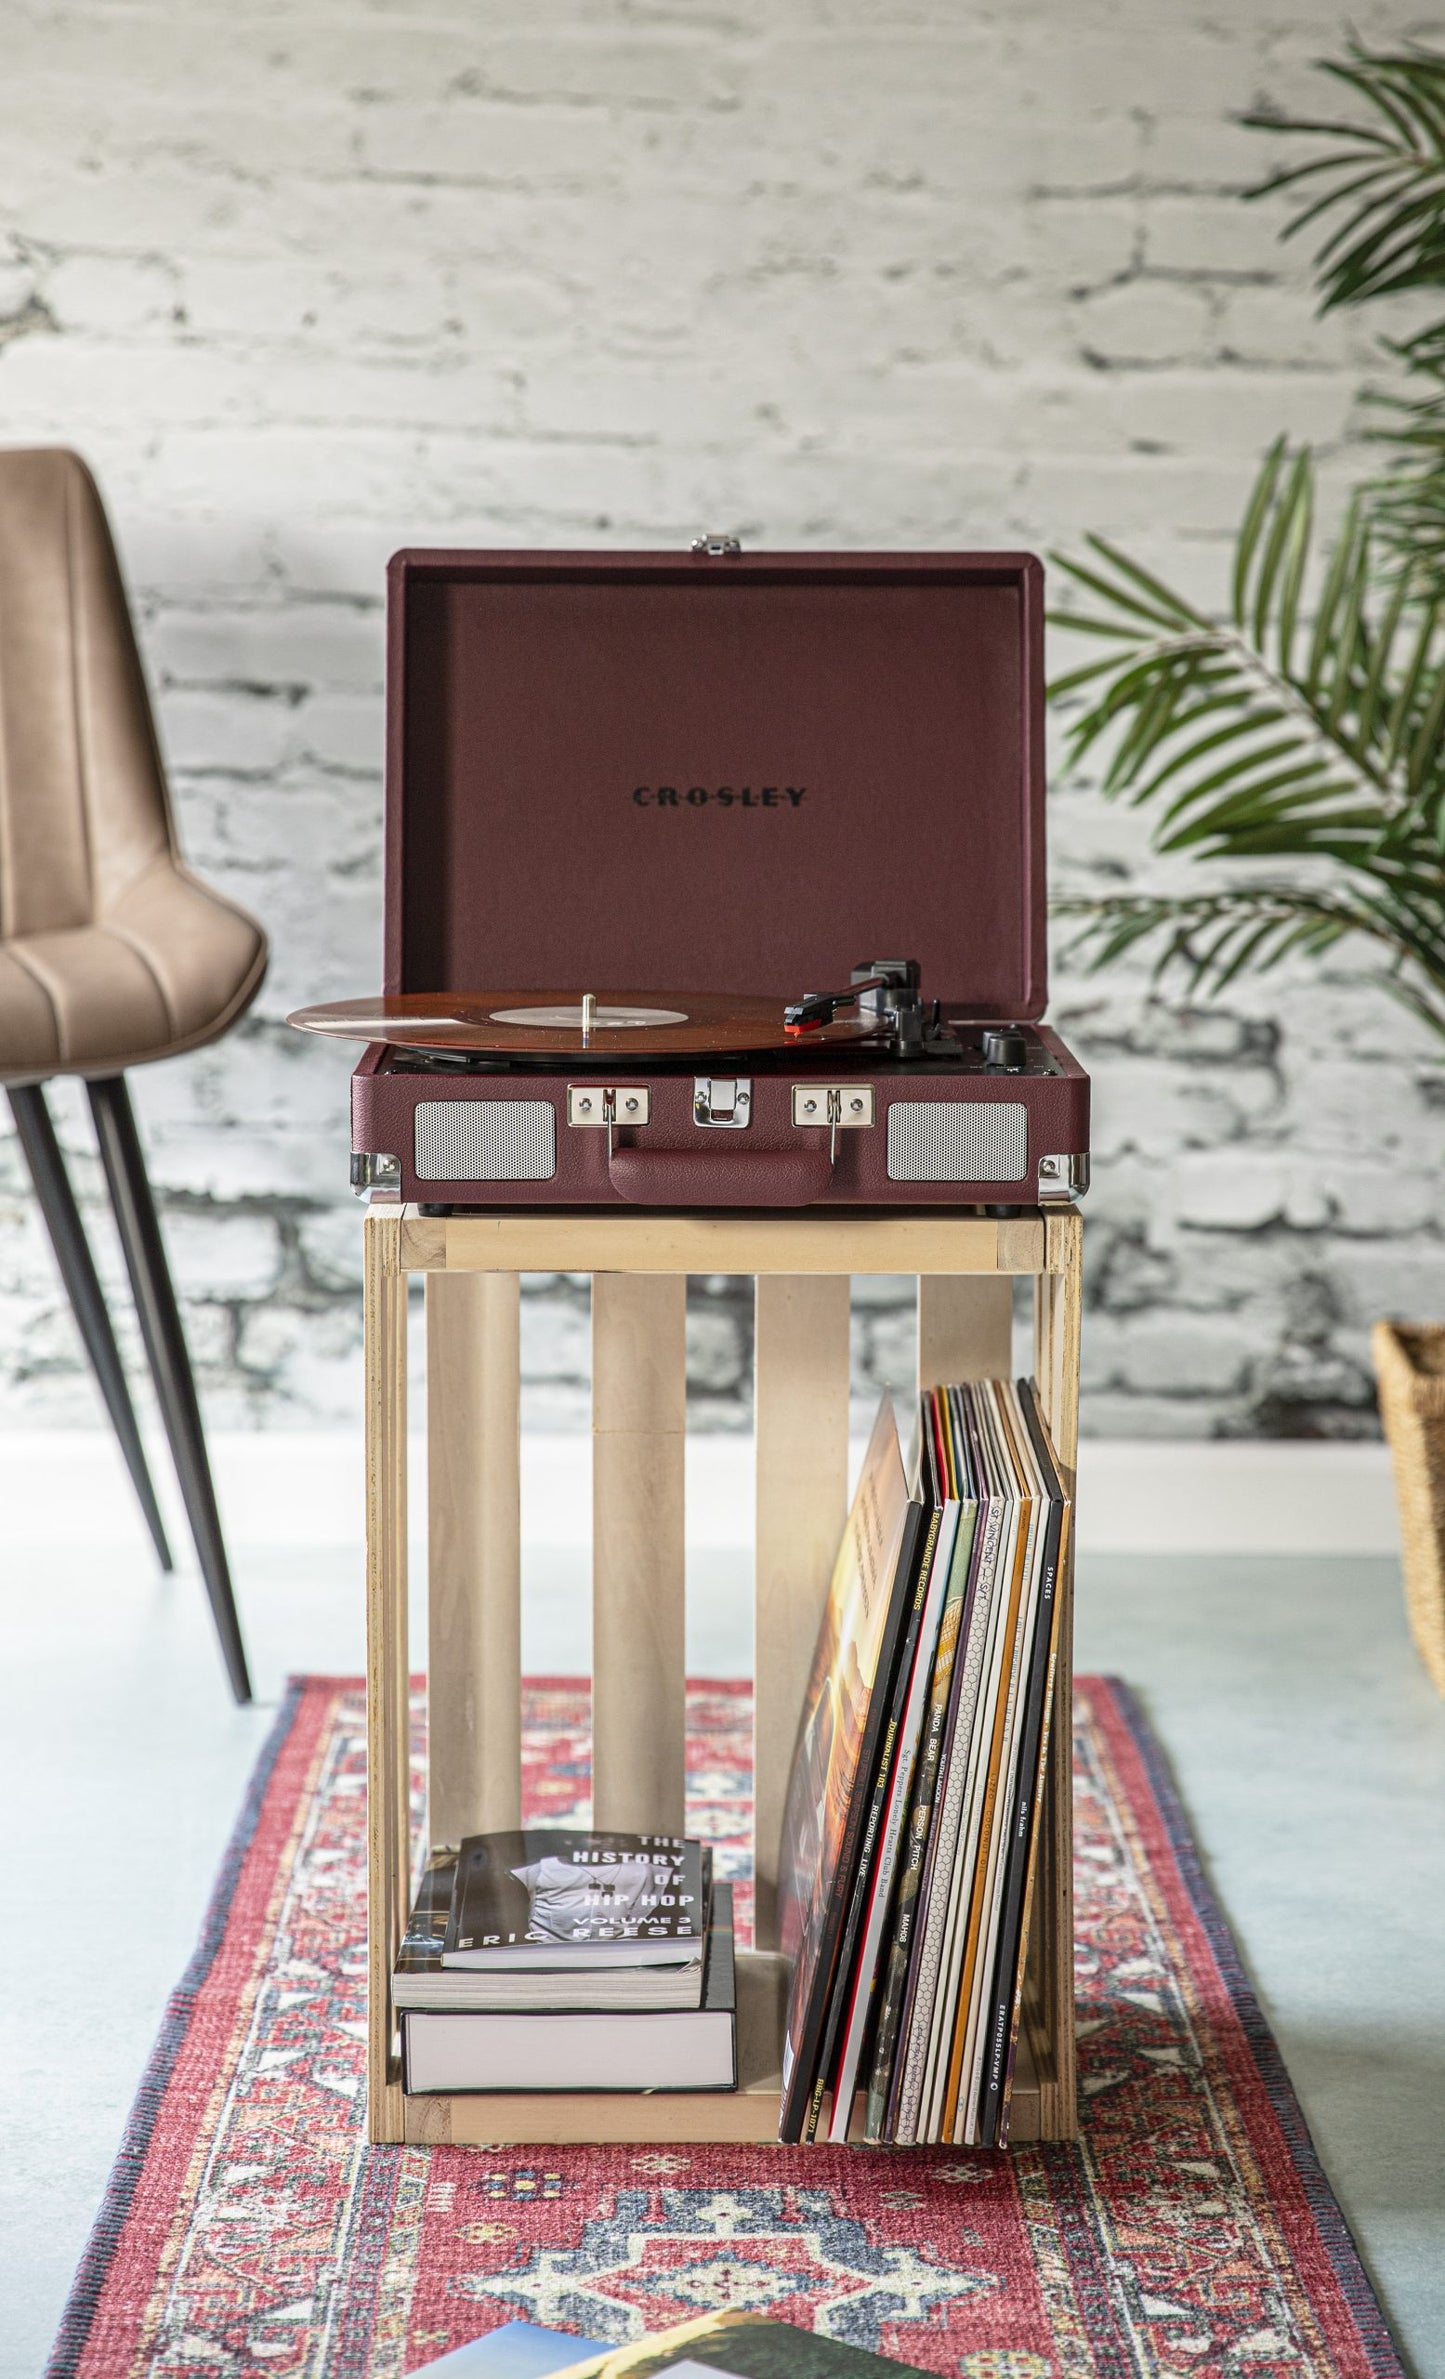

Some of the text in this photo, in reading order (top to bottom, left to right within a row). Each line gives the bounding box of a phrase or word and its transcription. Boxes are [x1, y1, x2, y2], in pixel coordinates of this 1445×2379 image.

[633, 786, 807, 807] CROSLEY
[983, 1523, 996, 1563] VINCENT
[913, 1512, 939, 1609] BABYGRANDE RECORDS
[1044, 1566, 1053, 1598] SPACES
[1047, 1652, 1056, 1688] Geoffrey
[938, 1753, 946, 1774] YOUTH
[858, 1718, 897, 1876] JOURNALIST 103 REPORTING LIVE
[878, 1749, 911, 1897] Sgt. Peppers Lonely Hearts Club Band
[899, 1703, 942, 1942] PANDA BEAR PERSON PITCH MAH08
[978, 1772, 996, 1873] LIZZO COCONUT OIL
[1018, 1816, 1026, 1836] frahm
[637, 1835, 686, 1848] THE
[841, 1831, 854, 1862] SOUND
[572, 1851, 686, 1866] HISTORY
[654, 1874, 686, 1886] OF
[835, 1874, 845, 1897] FURY
[583, 1894, 695, 1907] HIP HOP
[572, 1917, 672, 1925] VOLUME
[458, 1926, 693, 1949] ERIC REESE
[807, 2078, 824, 2132] BBG-LP-1071
